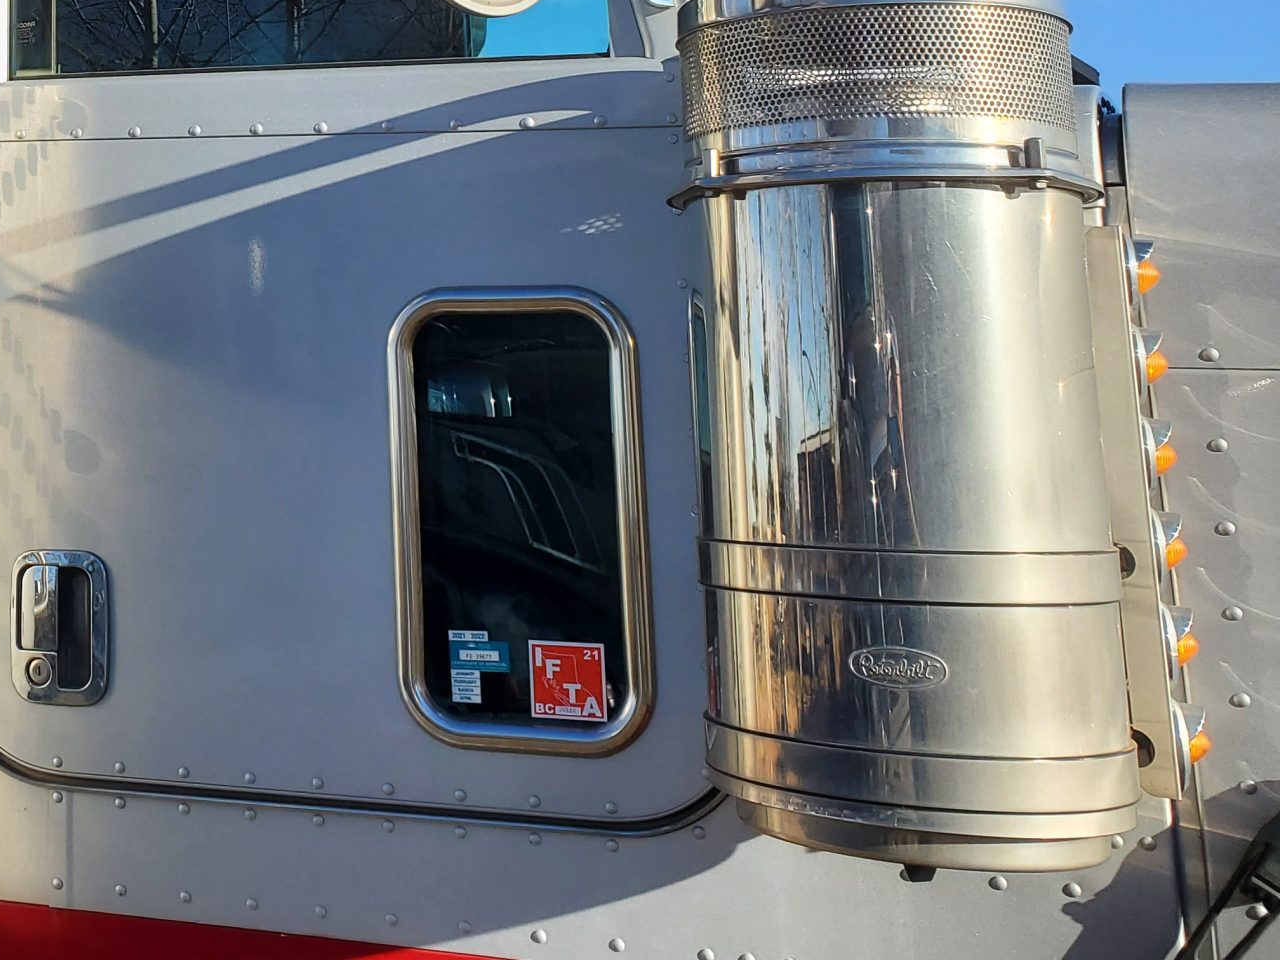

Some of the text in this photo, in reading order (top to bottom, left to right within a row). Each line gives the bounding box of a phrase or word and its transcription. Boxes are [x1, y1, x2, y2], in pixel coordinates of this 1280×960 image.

[583, 649, 599, 661] 21
[858, 652, 940, 680] Peterbilt
[535, 702, 554, 714] BC
